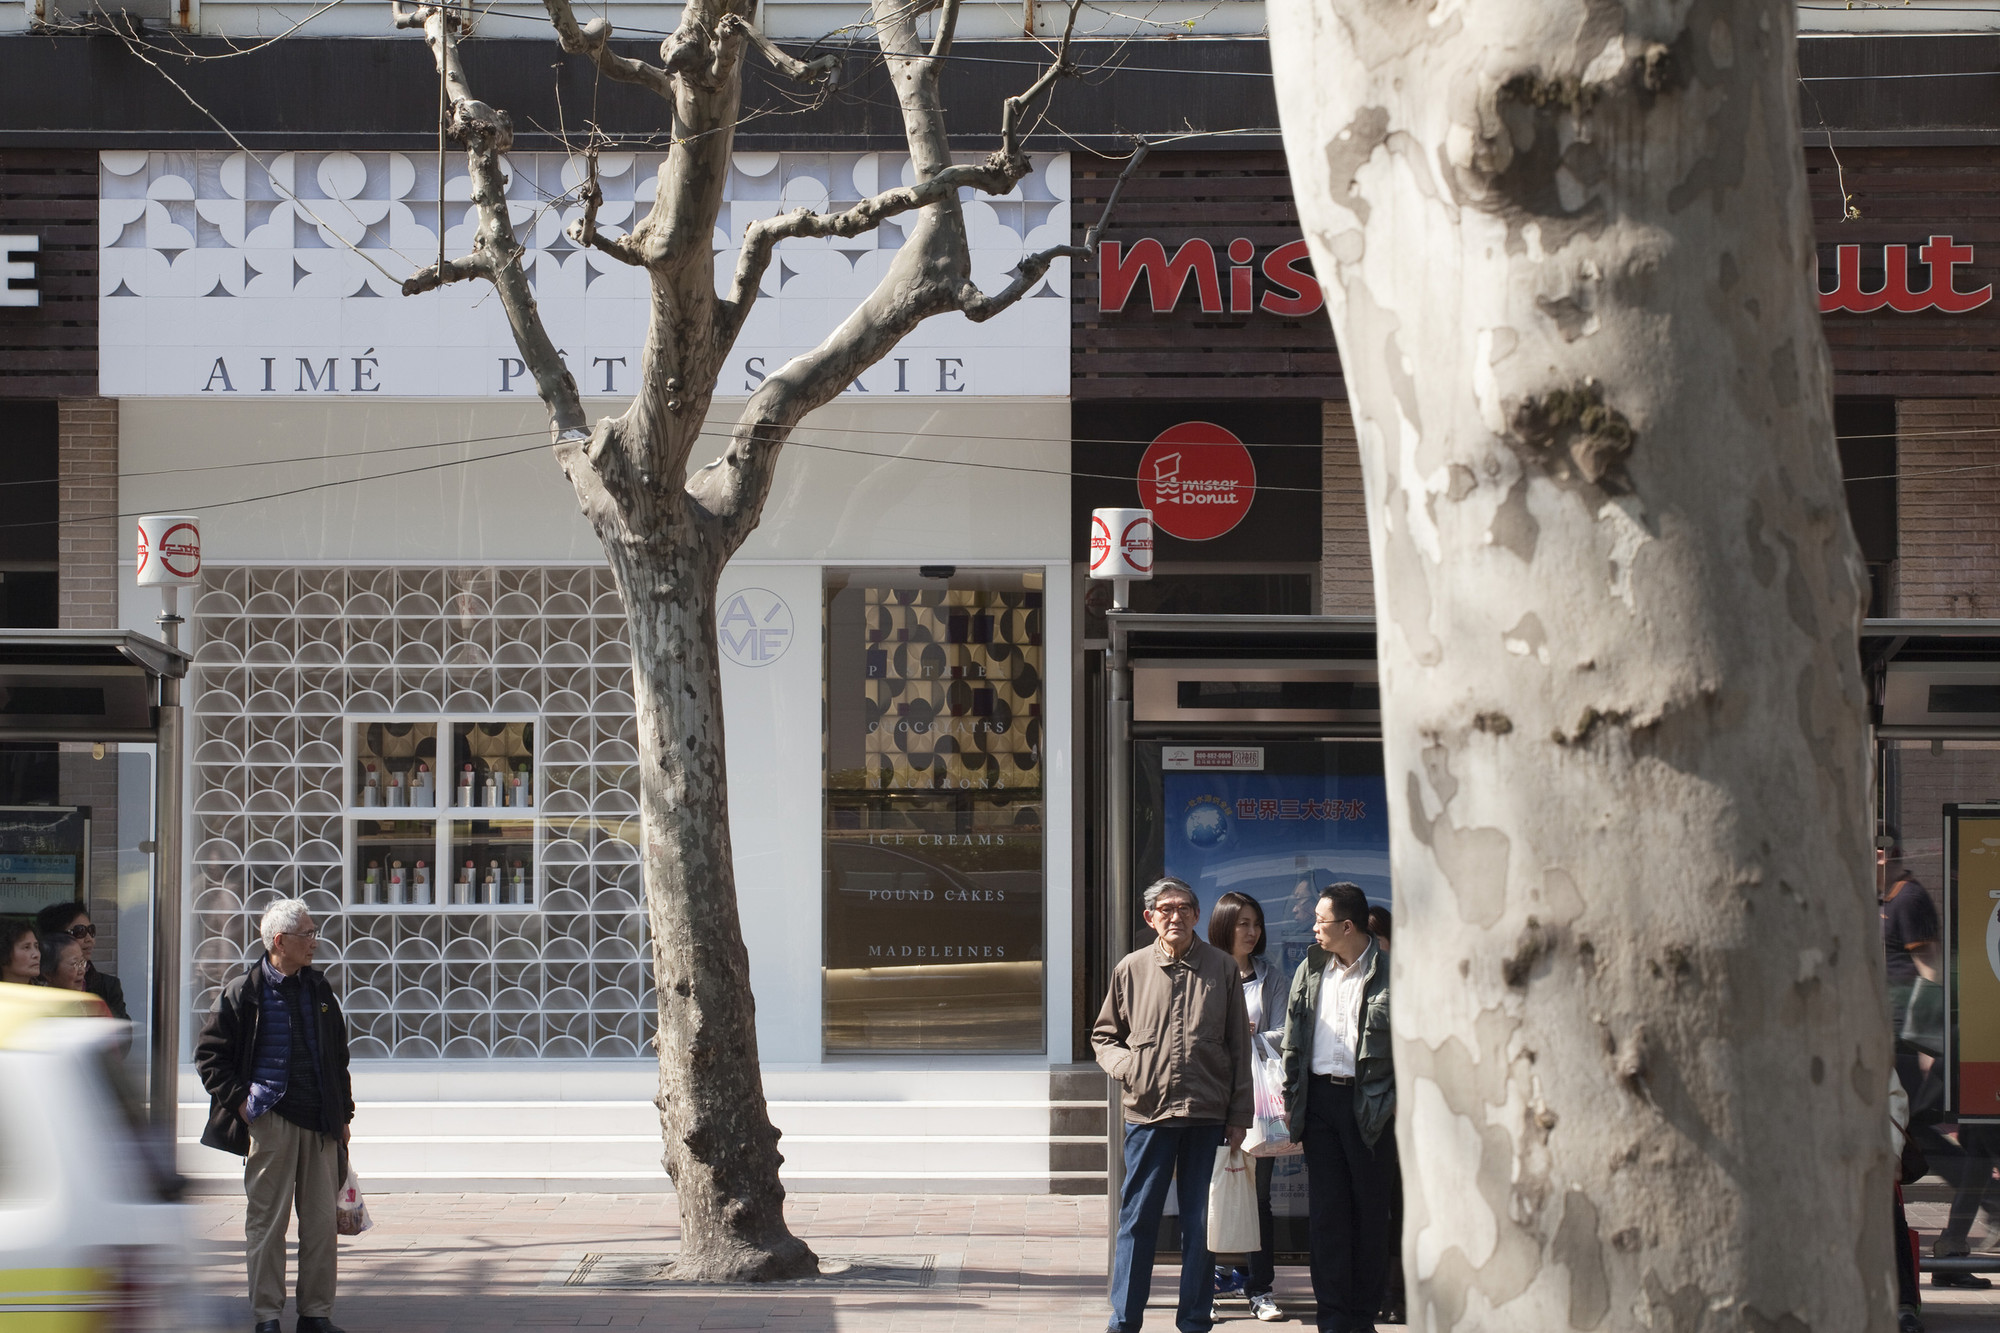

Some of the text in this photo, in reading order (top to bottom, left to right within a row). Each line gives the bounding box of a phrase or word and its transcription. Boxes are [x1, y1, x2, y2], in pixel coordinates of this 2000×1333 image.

[201, 347, 382, 392] AIMÉ
[1182, 493, 1239, 504] Donut
[869, 721, 1005, 733] CHOCOLATES
[868, 778, 1005, 790] MACARONS
[1236, 798, 1367, 822] 世界三大好水
[869, 834, 1005, 846] ICE CREAMS
[869, 890, 1006, 901] POUND CAKES
[868, 945, 1006, 957] MADELEINES
